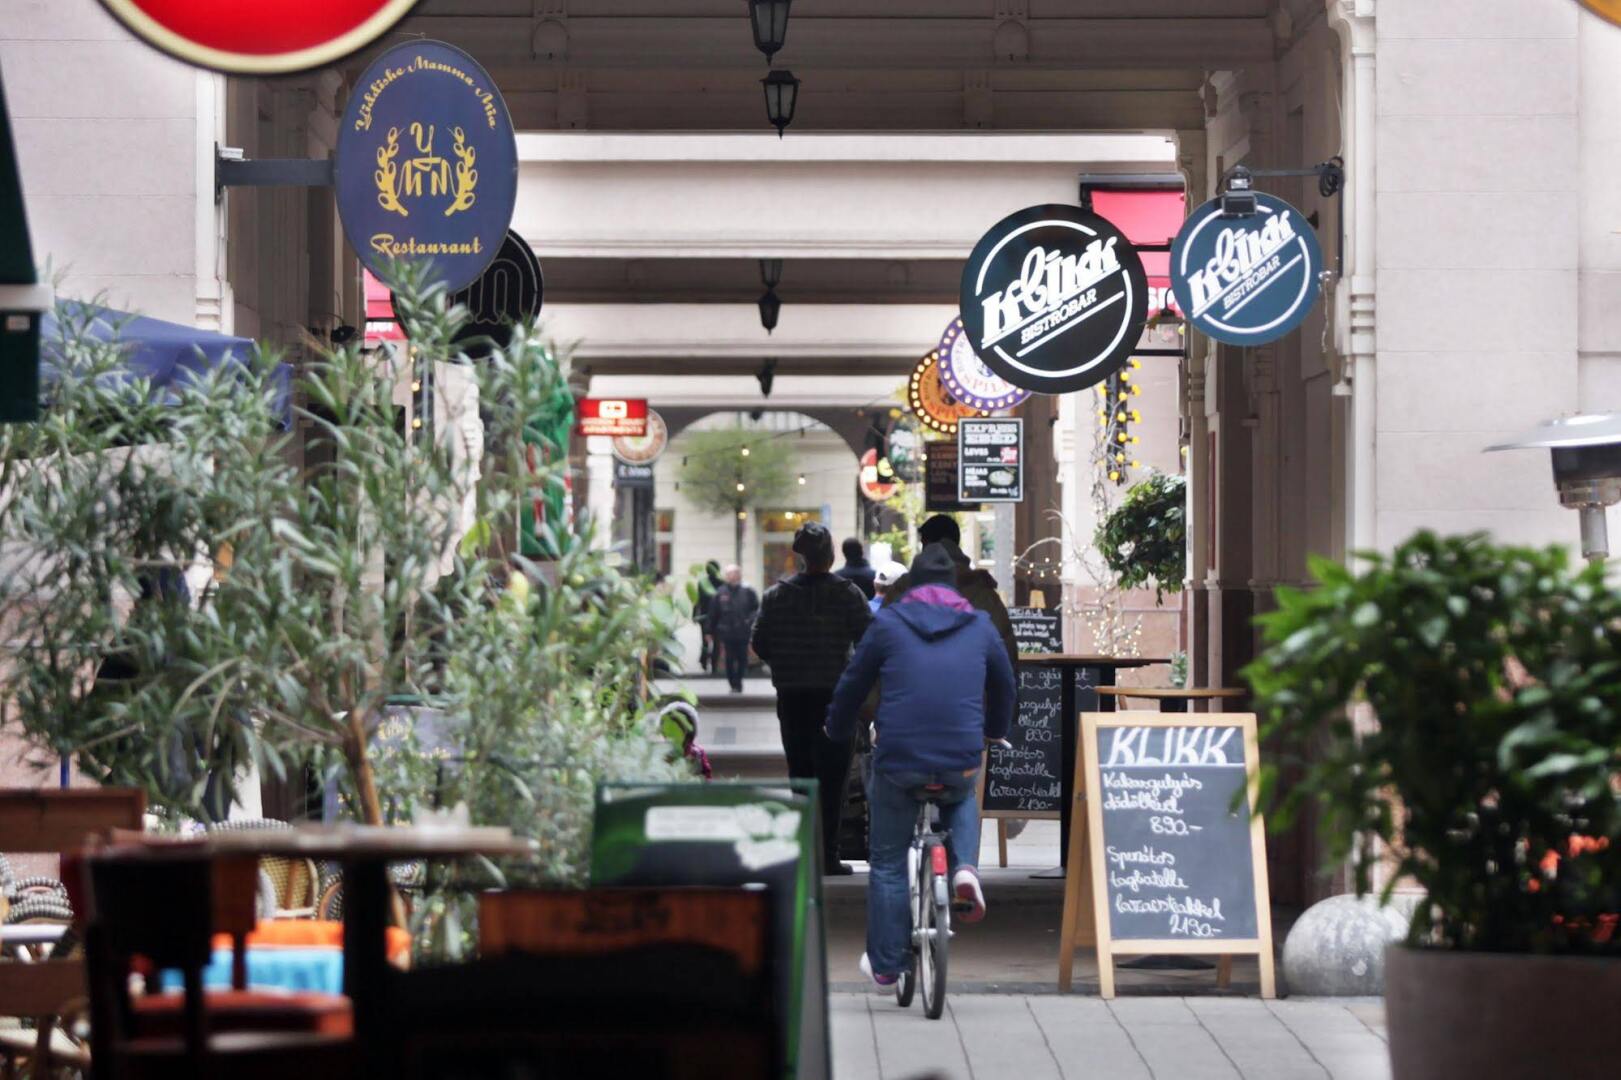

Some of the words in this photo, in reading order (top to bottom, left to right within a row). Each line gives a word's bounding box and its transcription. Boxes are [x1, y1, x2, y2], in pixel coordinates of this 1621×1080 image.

[355, 67, 405, 131] Yiddishe
[407, 55, 475, 87] Mamma
[475, 87, 497, 130] Mia
[370, 233, 483, 258] Restaurant
[1222, 255, 1281, 309] BISTROBAR
[1020, 288, 1097, 345] BISTROBAR
[1107, 727, 1236, 767] KLIKK
